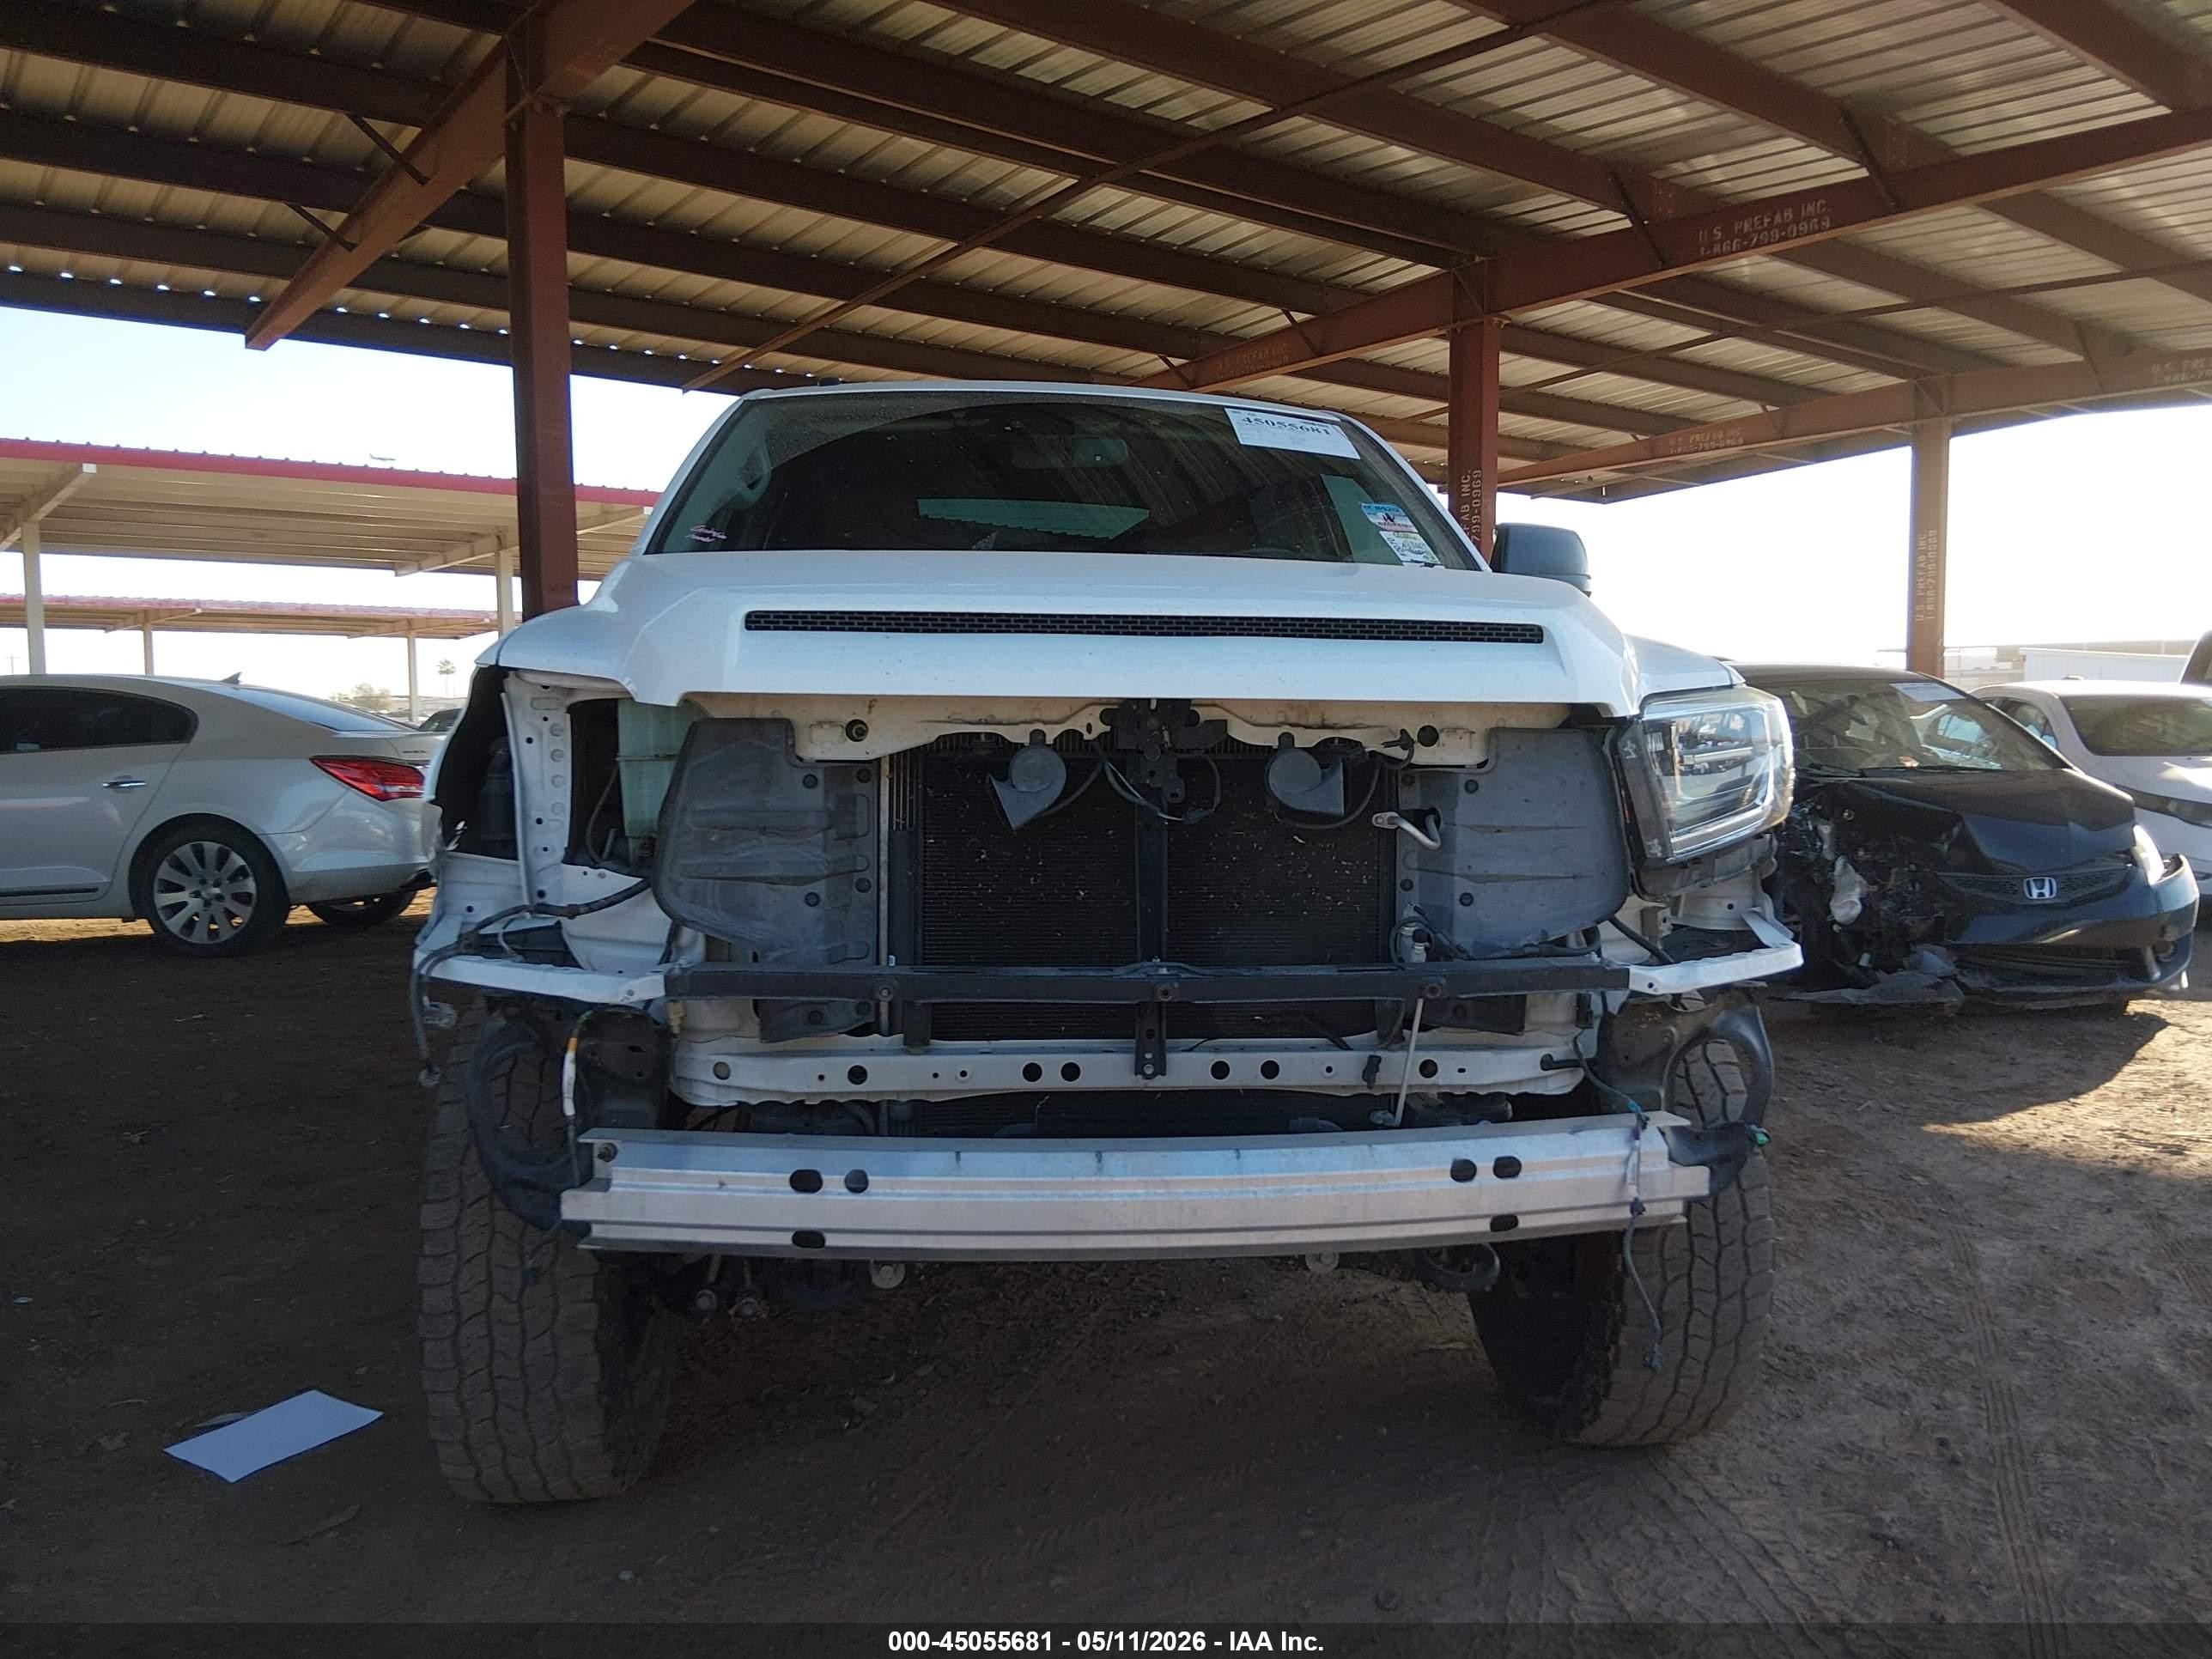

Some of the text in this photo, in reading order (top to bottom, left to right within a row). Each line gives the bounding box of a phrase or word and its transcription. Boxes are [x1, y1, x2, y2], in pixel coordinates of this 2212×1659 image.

[1734, 207, 1793, 234] PREFAB
[1801, 198, 1831, 219] INC.
[1461, 470, 1472, 497] INC.
